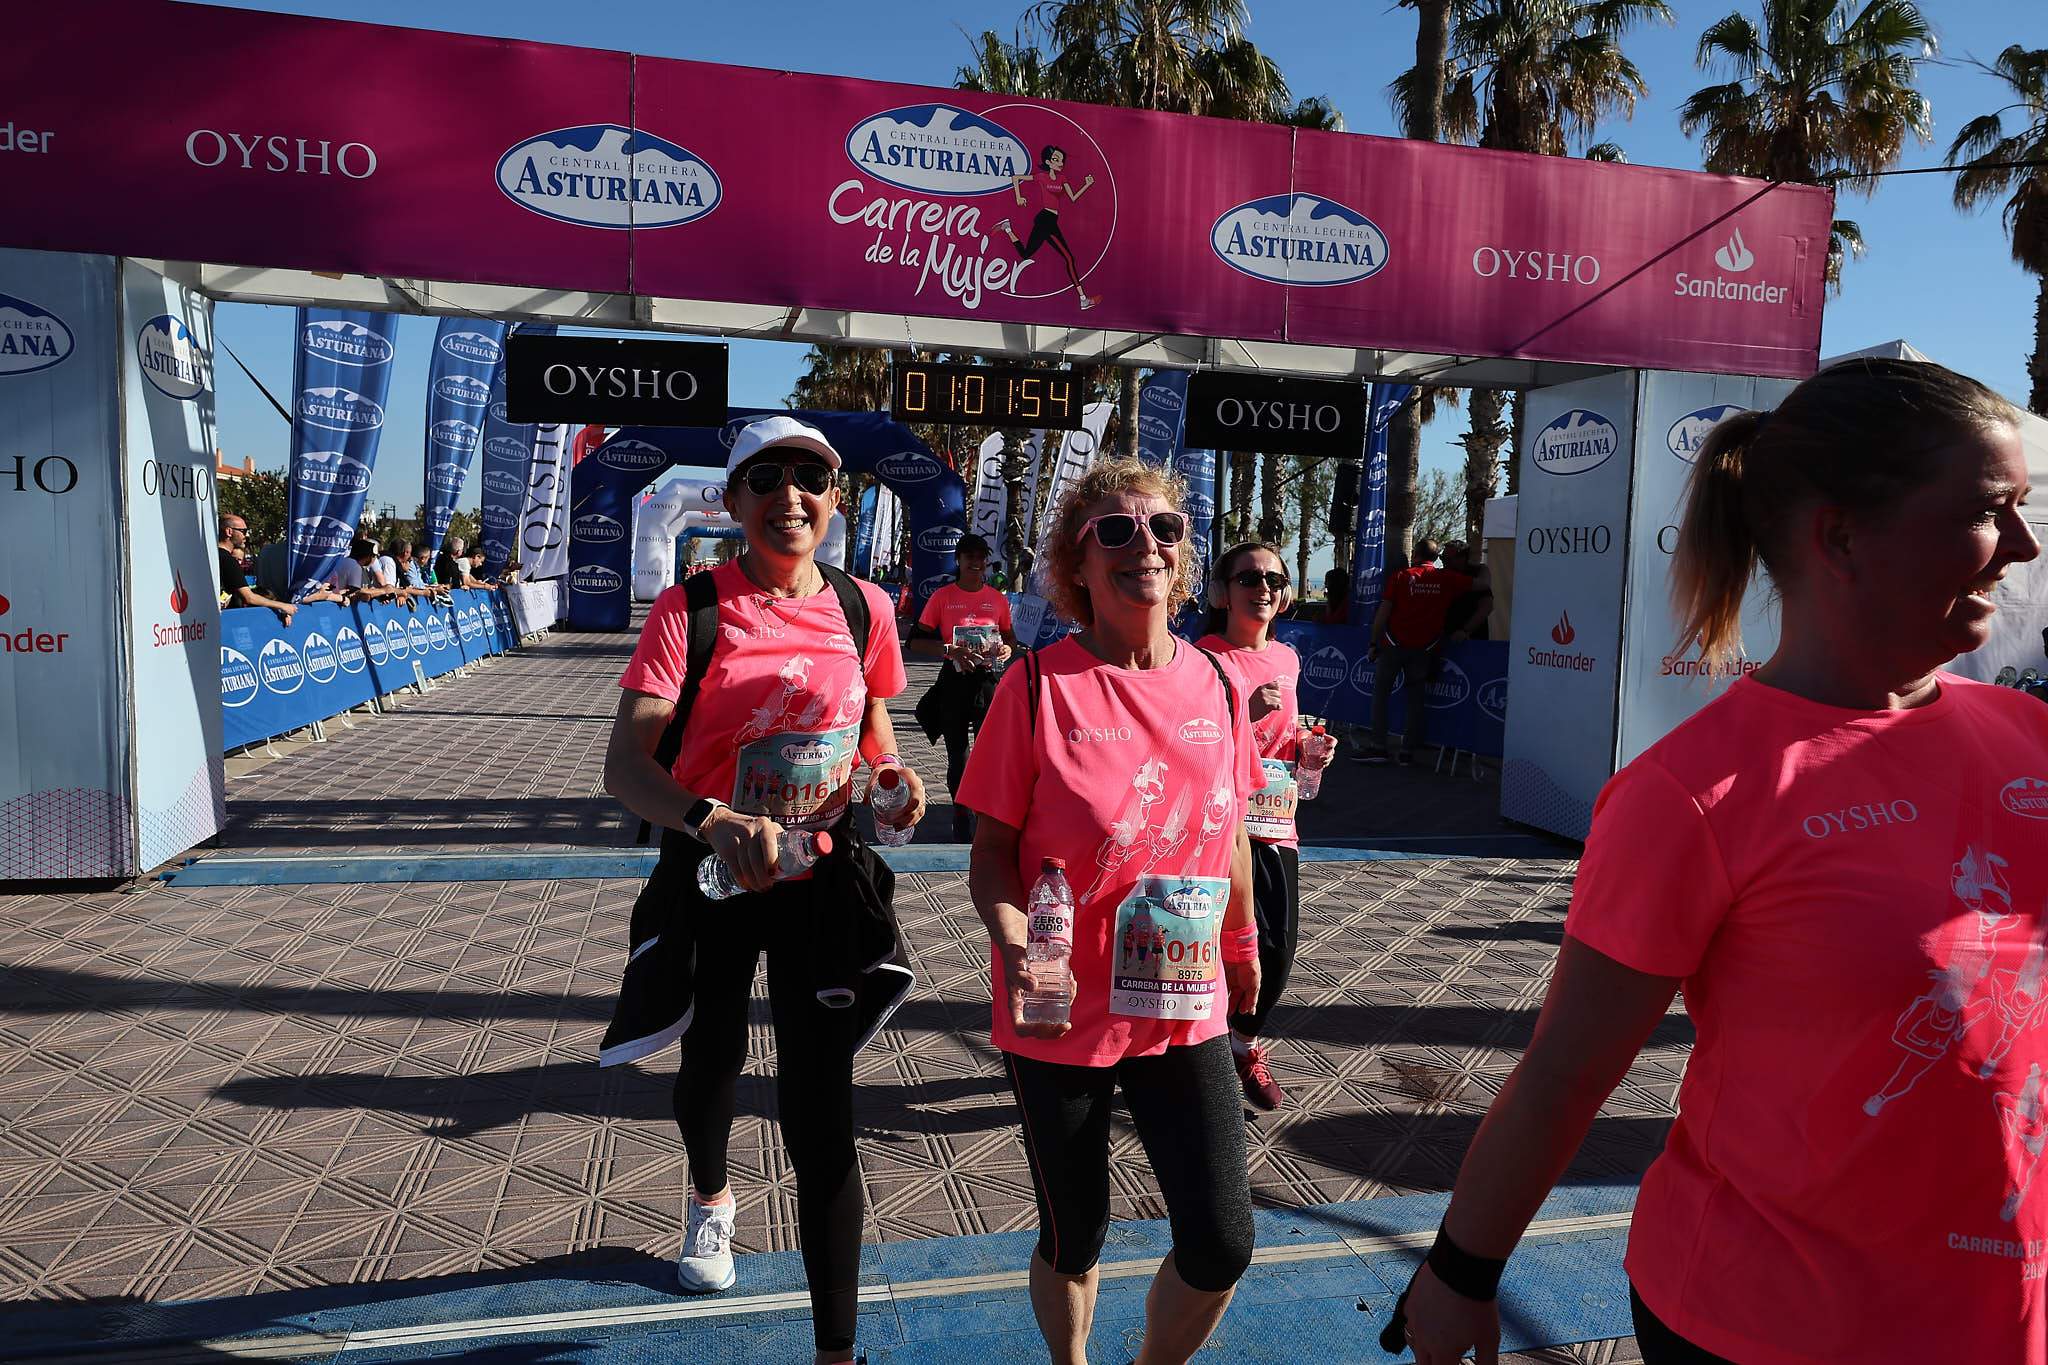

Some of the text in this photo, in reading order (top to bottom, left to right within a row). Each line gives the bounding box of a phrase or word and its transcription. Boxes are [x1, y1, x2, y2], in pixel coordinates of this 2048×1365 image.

[889, 130, 1013, 152] CENTRAL LECHERA
[185, 129, 378, 179] OYSHO
[549, 155, 617, 171] CENTRAL
[860, 130, 1016, 177] ASTURIANA
[513, 155, 705, 208] ASTURIANA
[828, 179, 983, 238] Carrera
[1253, 221, 1371, 240] CENTRAL LECHERA
[1225, 221, 1376, 267] ASTURIANA
[864, 232, 1036, 310] de la Mujer
[1472, 246, 1601, 286] OYSHO
[1673, 272, 1788, 305] Santander
[0, 319, 52, 332] CHERA
[304, 329, 387, 360] ASTURIANA
[143, 335, 203, 386] ASTURIANA
[543, 363, 698, 401] OYSHO
[1216, 397, 1342, 433] OYSHO
[601, 450, 662, 465] ASTURIANA
[1537, 437, 1611, 462] ASTURIANA
[143, 459, 209, 502] OYSHO
[881, 461, 938, 476] ASTURIANA
[573, 524, 621, 538] ASTURIANA
[1528, 525, 1611, 555] OYSHO
[571, 573, 619, 588] ASTURIANA
[153, 618, 207, 648] Santander
[264, 661, 303, 683] ASTURIANA
[1307, 662, 1343, 681] ASTURIANA
[1528, 647, 1596, 673] Santander
[1068, 726, 1132, 744] OYSHO
[790, 804, 814, 815] 5757
[1255, 793, 1282, 808] 016
[786, 816, 796, 824] LA
[1802, 799, 1919, 839] OYSHO
[1033, 915, 1063, 924] ZERO
[1033, 923, 1063, 932] SODIO
[1166, 940, 1211, 964] 016
[1121, 979, 1160, 991] CARRERA
[1161, 982, 1173, 991] DE
[1173, 983, 1184, 992] LA
[1177, 969, 1203, 980] 8975
[1128, 996, 1177, 1010] OYSHO
[1947, 1232, 2025, 1259] CARRERA
